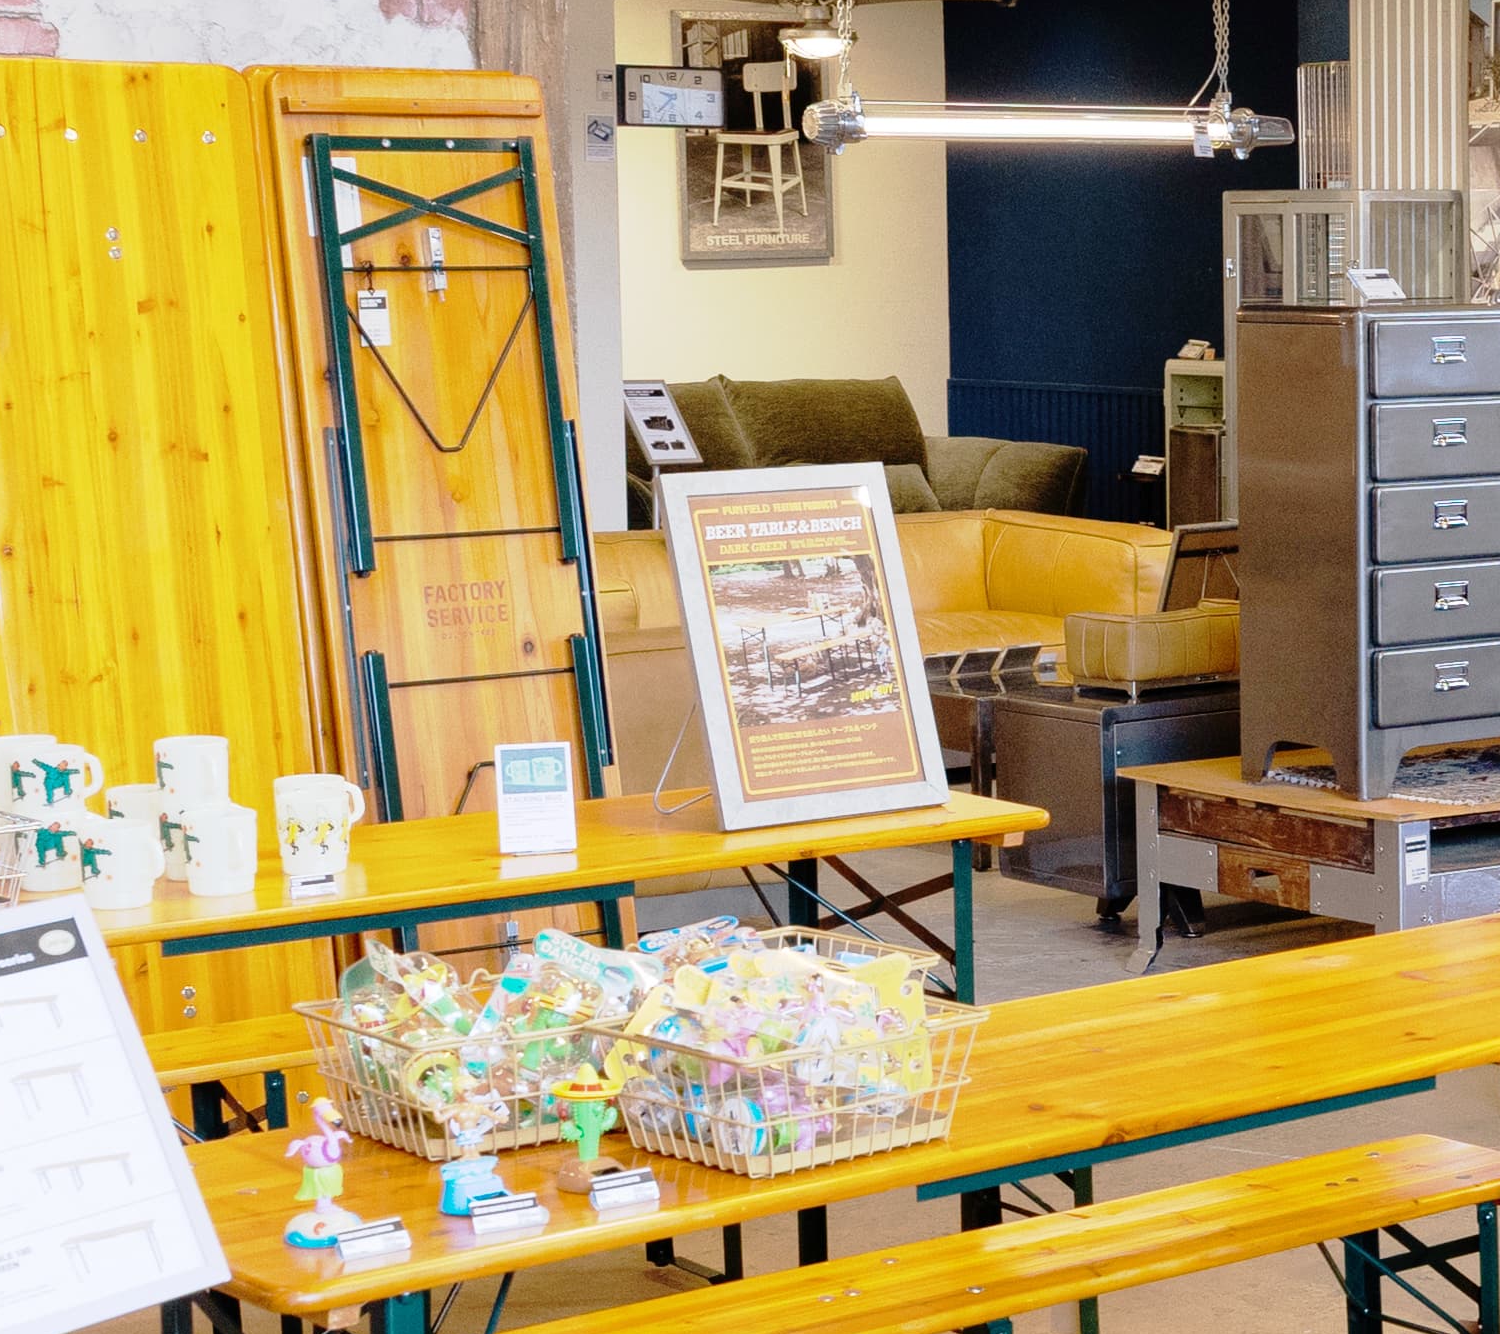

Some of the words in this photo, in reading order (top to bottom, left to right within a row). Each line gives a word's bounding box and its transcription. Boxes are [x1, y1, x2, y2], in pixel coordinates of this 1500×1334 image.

[640, 74, 651, 83] 10
[666, 72, 677, 81] 12
[694, 76, 702, 85] 2
[706, 235, 743, 246] STEEL
[745, 233, 810, 246] FURNITURE
[705, 523, 747, 540] BEER
[720, 542, 749, 555] DARK
[751, 540, 787, 552] GREEN
[423, 580, 505, 604] FACTORY
[427, 604, 508, 627] SERVICE
